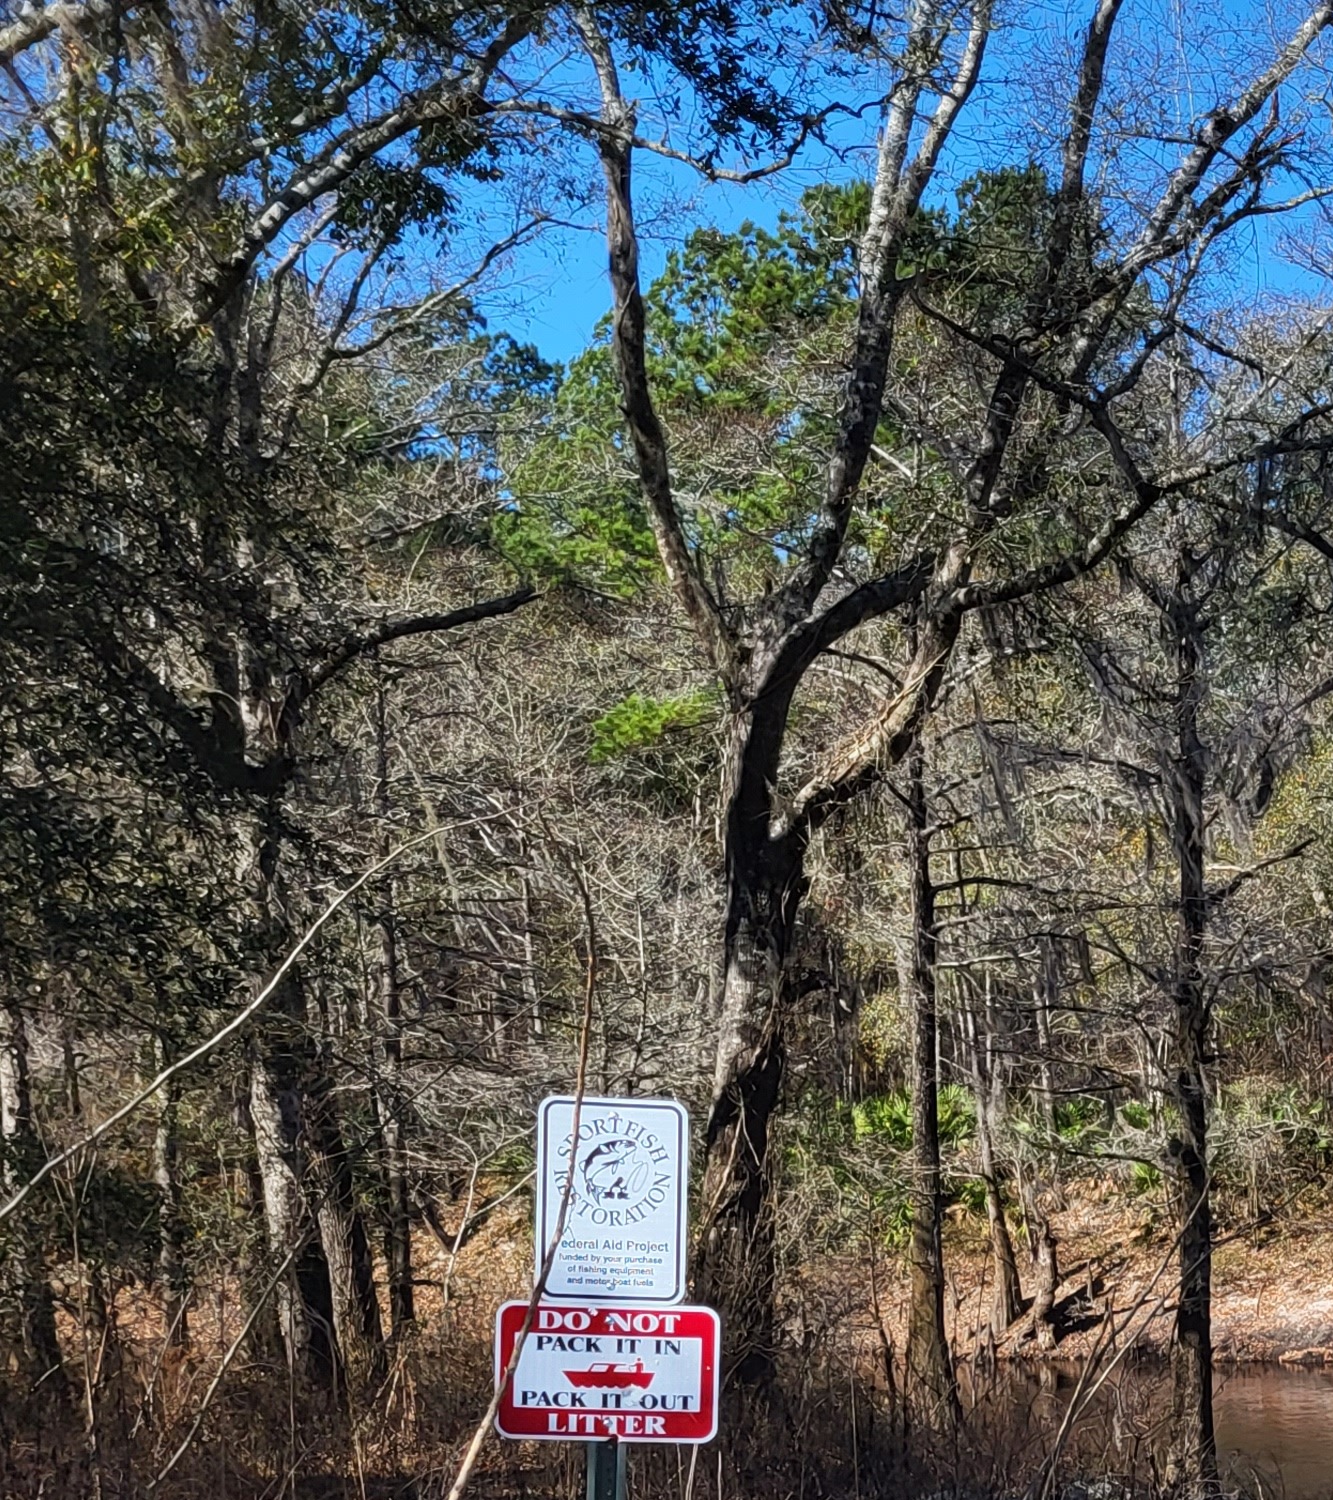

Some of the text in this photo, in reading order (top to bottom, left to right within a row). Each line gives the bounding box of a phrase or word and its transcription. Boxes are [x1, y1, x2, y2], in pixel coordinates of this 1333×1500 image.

[553, 1170, 671, 1226] RESTORATION
[561, 1239, 598, 1249] ederal
[627, 1240, 669, 1254] Project
[538, 1310, 681, 1333] DO NOT
[536, 1335, 681, 1355] PACK IT IN
[521, 1390, 694, 1410] PACK IT OUT
[548, 1413, 666, 1435] LITTER
